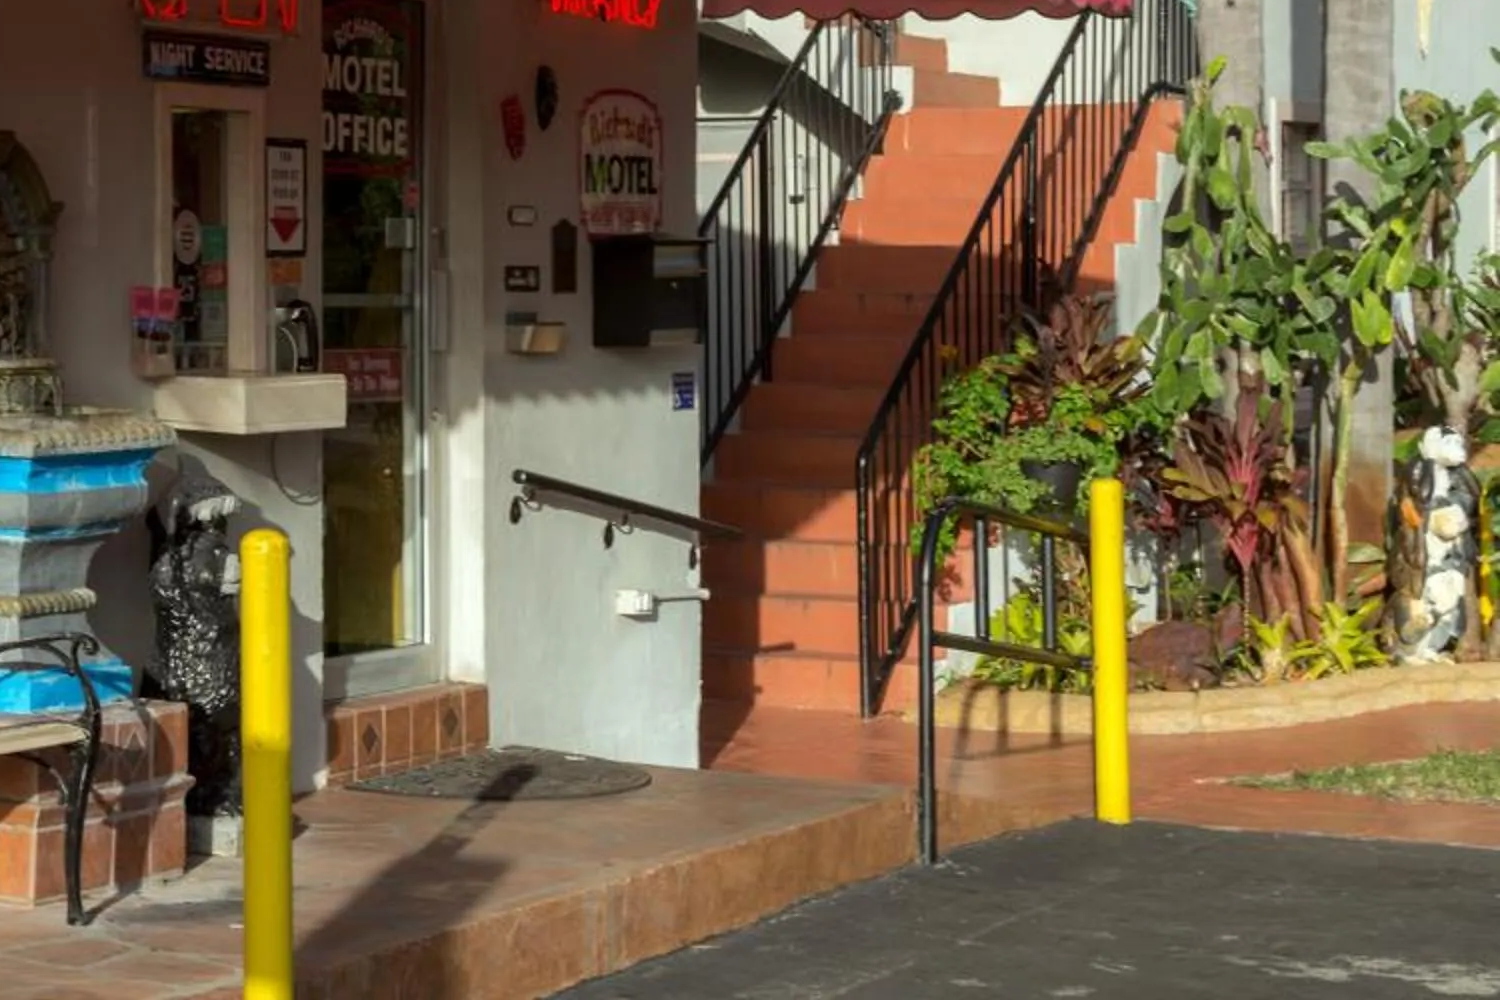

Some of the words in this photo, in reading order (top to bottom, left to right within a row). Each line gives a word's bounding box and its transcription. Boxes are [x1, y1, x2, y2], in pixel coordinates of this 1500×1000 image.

[150, 41, 197, 69] NIGHT
[203, 46, 266, 75] SERVICE
[322, 53, 407, 97] MOTEL
[321, 110, 409, 157] OFFICE
[584, 153, 658, 196] MOTEL
